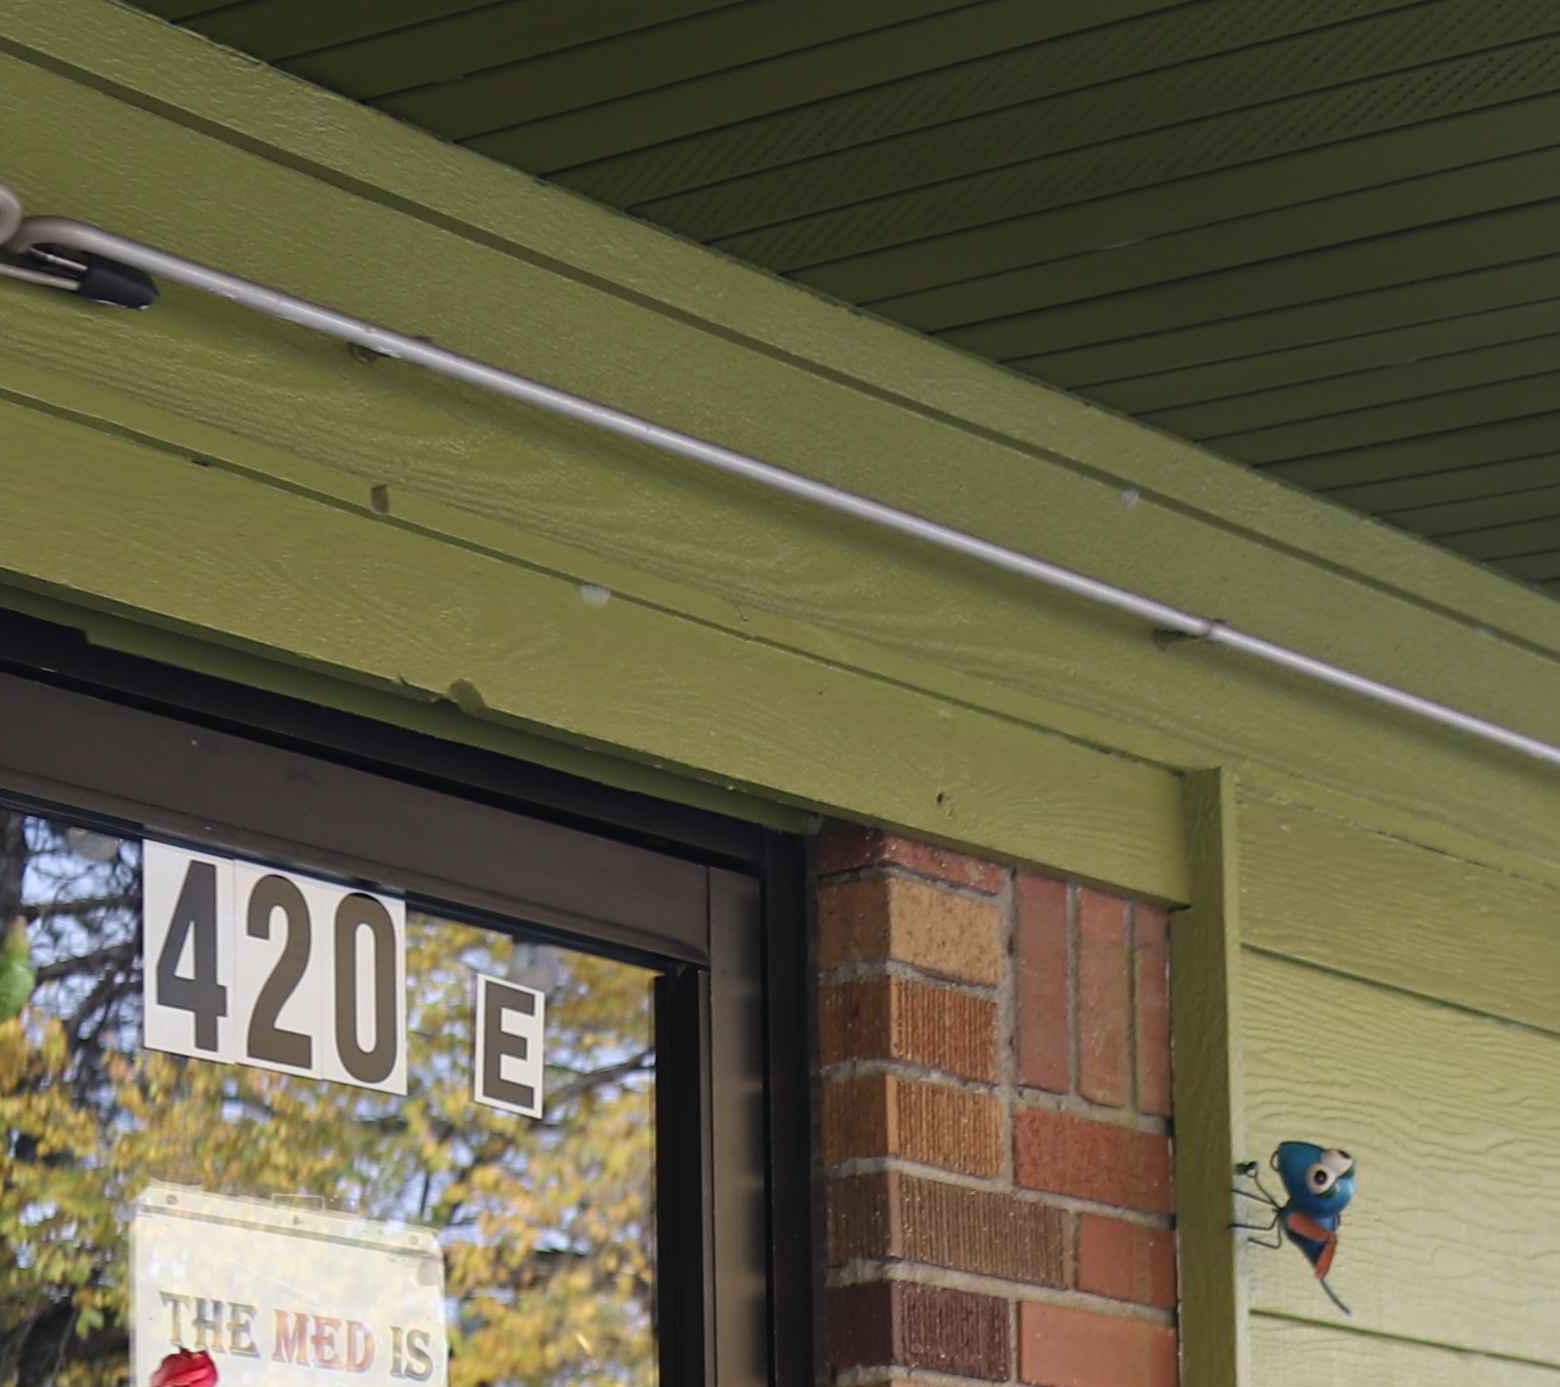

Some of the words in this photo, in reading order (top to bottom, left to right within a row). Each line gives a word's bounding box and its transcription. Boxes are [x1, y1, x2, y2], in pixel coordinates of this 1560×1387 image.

[156, 860, 398, 1083] 420
[482, 980, 536, 1110] E
[159, 1290, 260, 1359] THE
[271, 1308, 376, 1374] MED
[389, 1326, 435, 1382] IS
